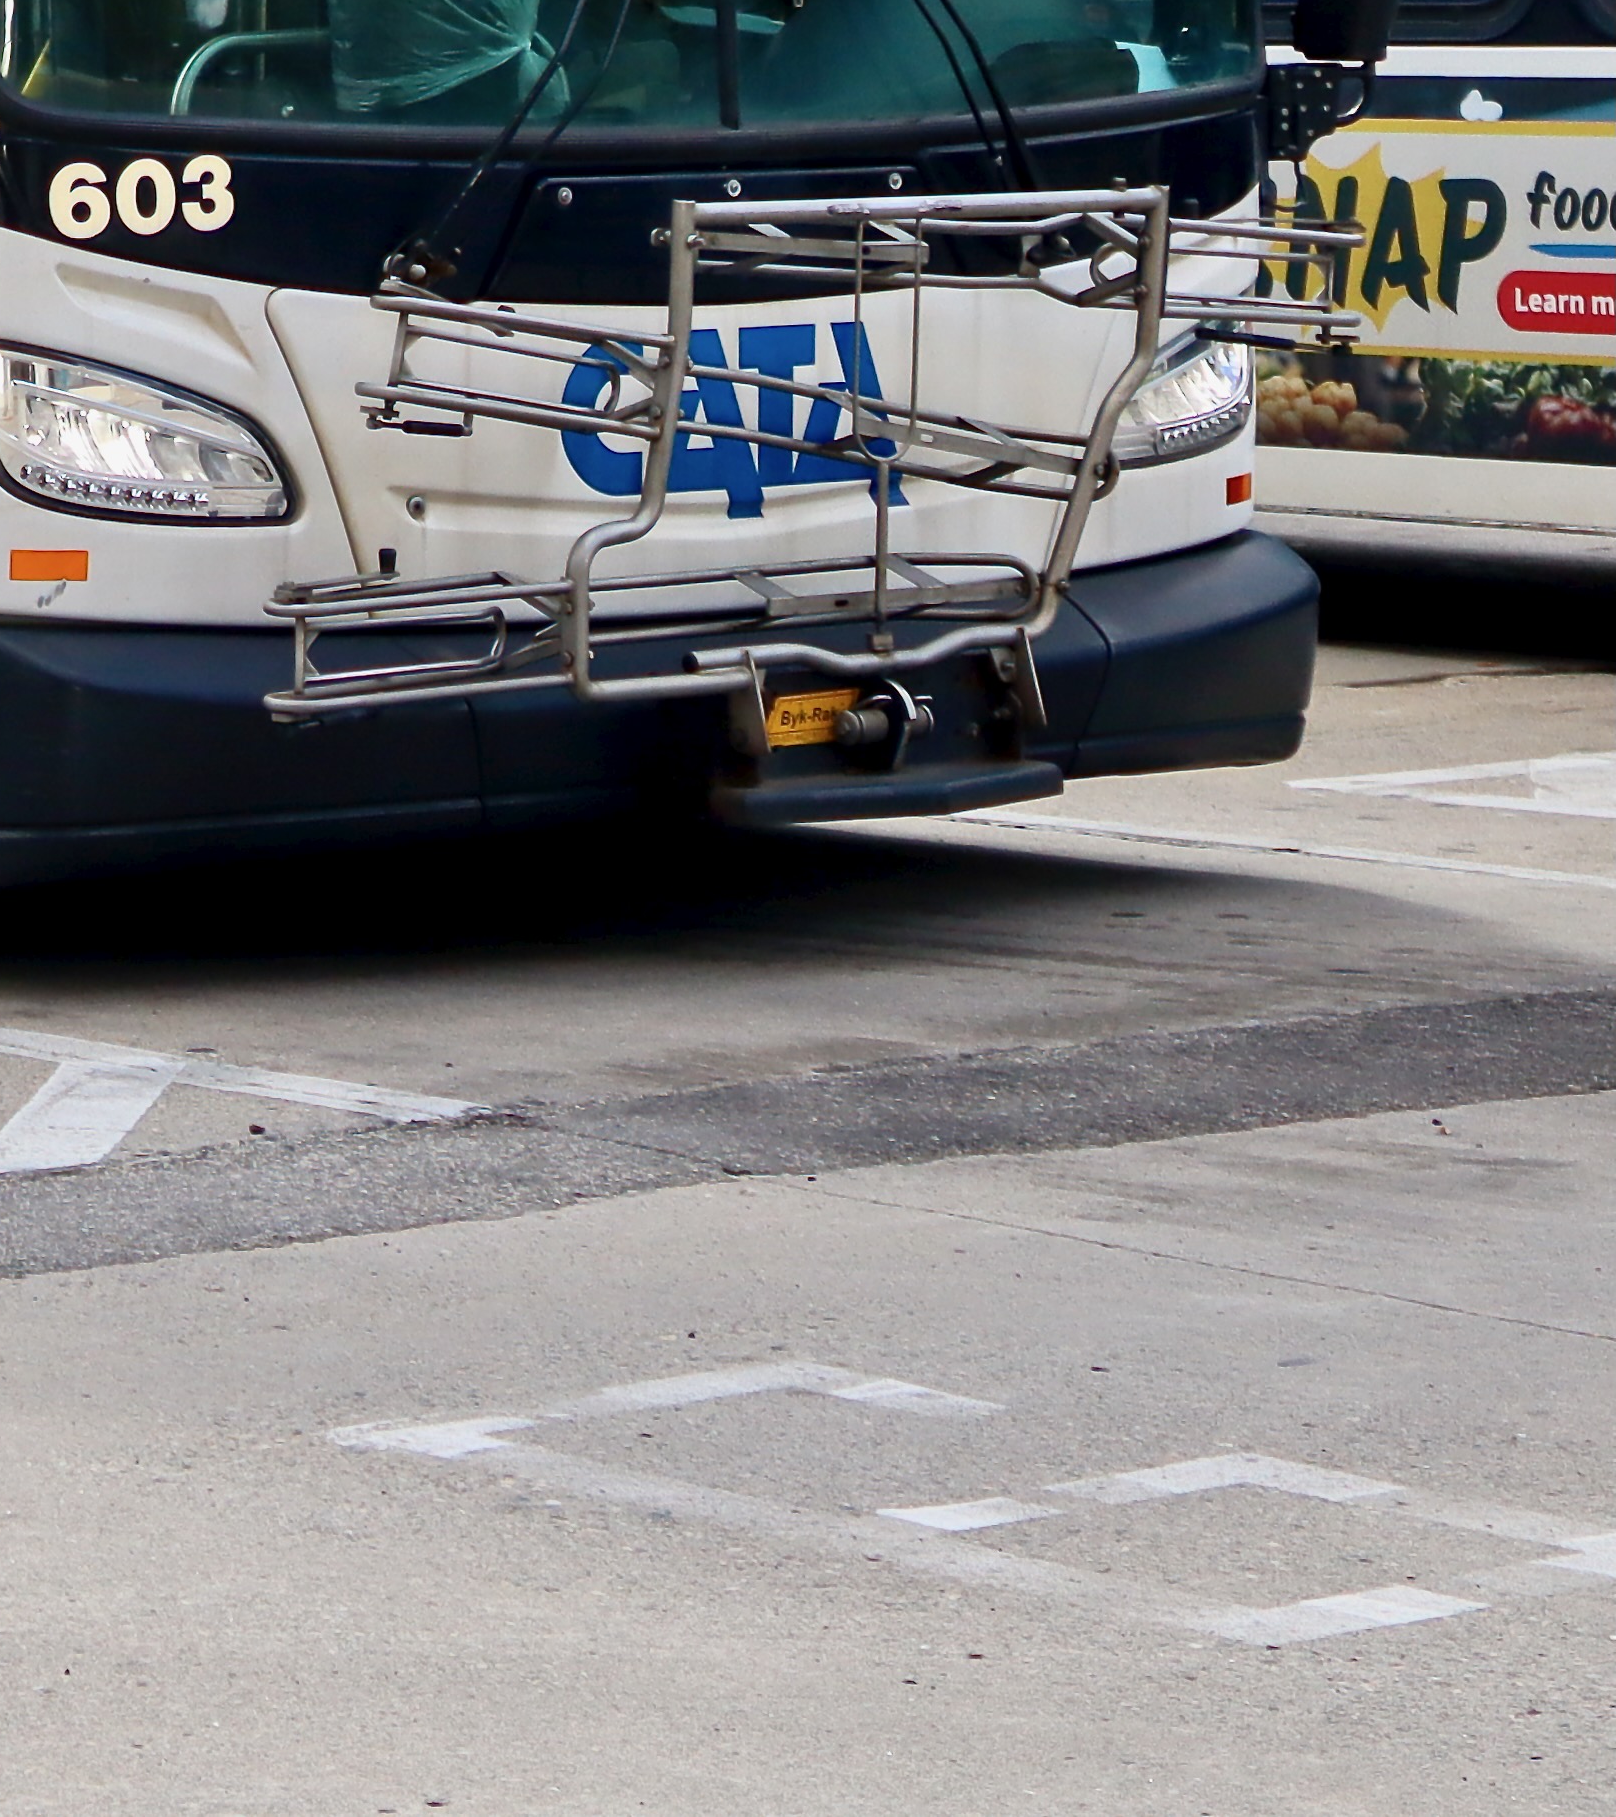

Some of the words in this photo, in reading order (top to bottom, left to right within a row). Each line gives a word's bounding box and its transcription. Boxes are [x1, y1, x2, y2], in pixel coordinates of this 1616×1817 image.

[48, 154, 235, 239] 603
[1514, 287, 1585, 315] Learn
[560, 321, 911, 519] CATA
